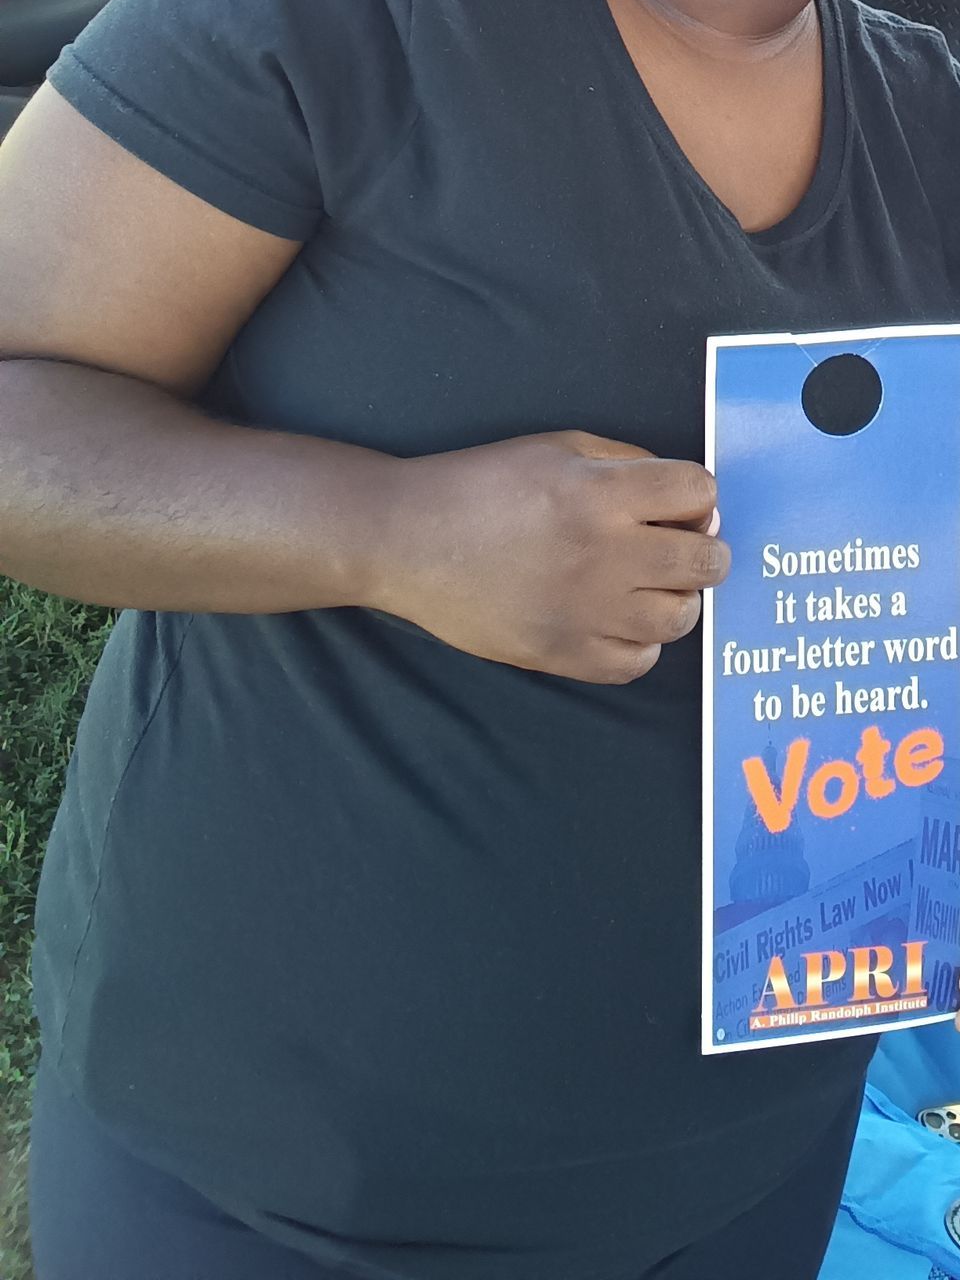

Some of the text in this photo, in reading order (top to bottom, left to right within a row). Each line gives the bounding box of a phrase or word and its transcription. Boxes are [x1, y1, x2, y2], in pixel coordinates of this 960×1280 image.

[762, 538, 920, 578] Sometimes
[775, 586, 907, 624] it takes a
[722, 626, 959, 676] four-letter word
[753, 676, 929, 721] to be heard.
[741, 725, 945, 833] Vote
[714, 940, 749, 983] Civil
[756, 915, 814, 964] Rights
[820, 896, 856, 932] Law
[751, 941, 929, 1012] APRI
[751, 998, 928, 1029] A. Philip Randolph Institute
